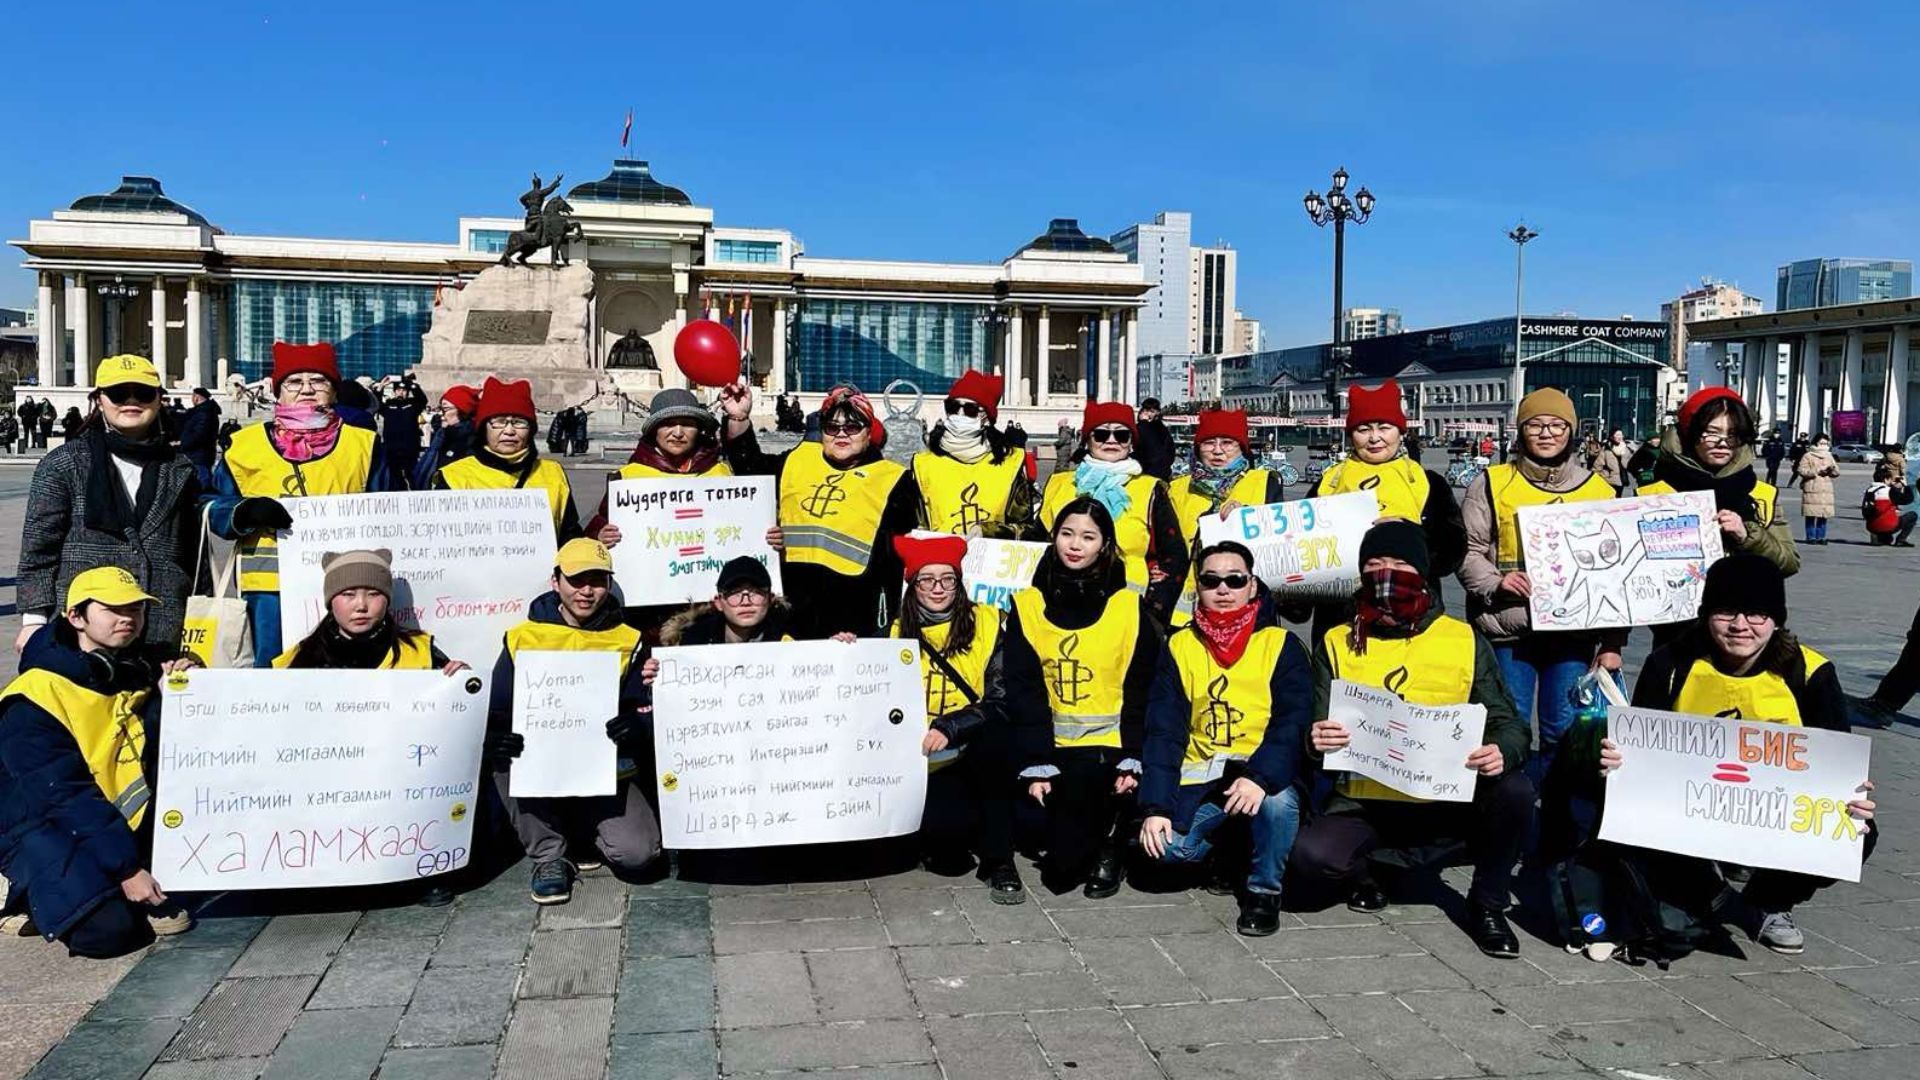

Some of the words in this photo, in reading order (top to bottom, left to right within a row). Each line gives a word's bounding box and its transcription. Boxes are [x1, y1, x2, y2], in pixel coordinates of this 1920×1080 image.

[1520, 324, 1579, 336] CASHMERE
[1582, 326, 1611, 337] COAT
[1614, 327, 1667, 339] COMPANY
[1631, 575, 1657, 587] FOR
[180, 628, 207, 643] RITE
[525, 671, 585, 690] Woman
[526, 692, 563, 710] Life
[525, 712, 588, 731] Freedom
[1615, 712, 1726, 759] МИНИЙ
[1736, 726, 1810, 771] БИЕ
[1686, 779, 1788, 829] МИНИЙ
[1790, 795, 1858, 841] ЭРХ
